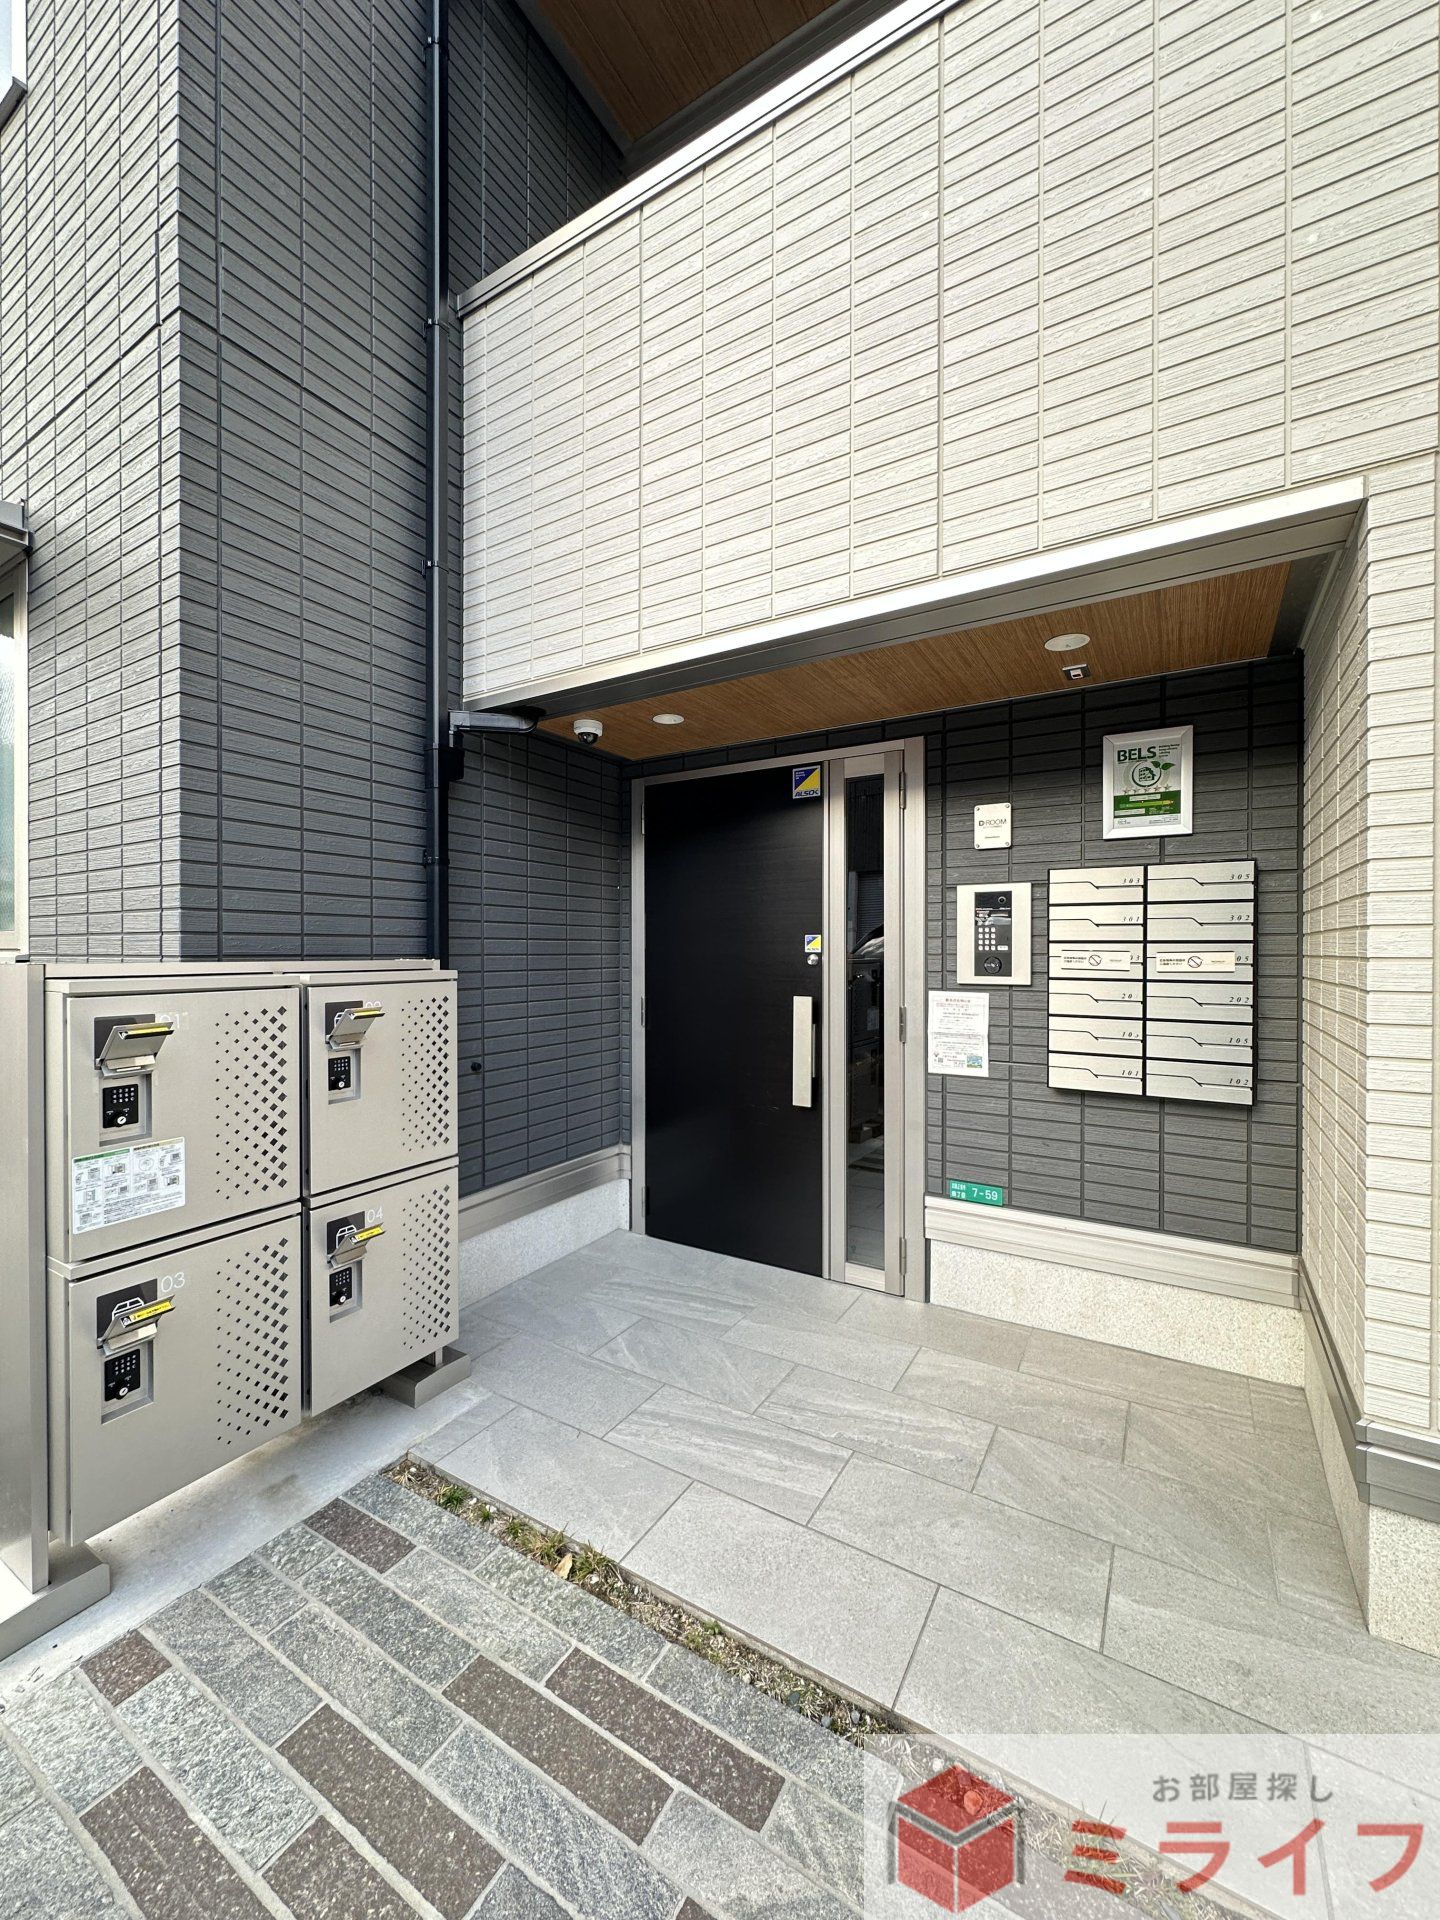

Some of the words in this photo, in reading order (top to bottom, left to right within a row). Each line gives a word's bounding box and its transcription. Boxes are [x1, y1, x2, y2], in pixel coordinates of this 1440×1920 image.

[1117, 746, 1157, 761] BELS
[1229, 996, 1250, 1004] 202
[1229, 1078, 1249, 1086] 102
[971, 1187, 998, 1200] 7-59
[366, 1207, 383, 1223] 04
[161, 1272, 185, 1292] 03
